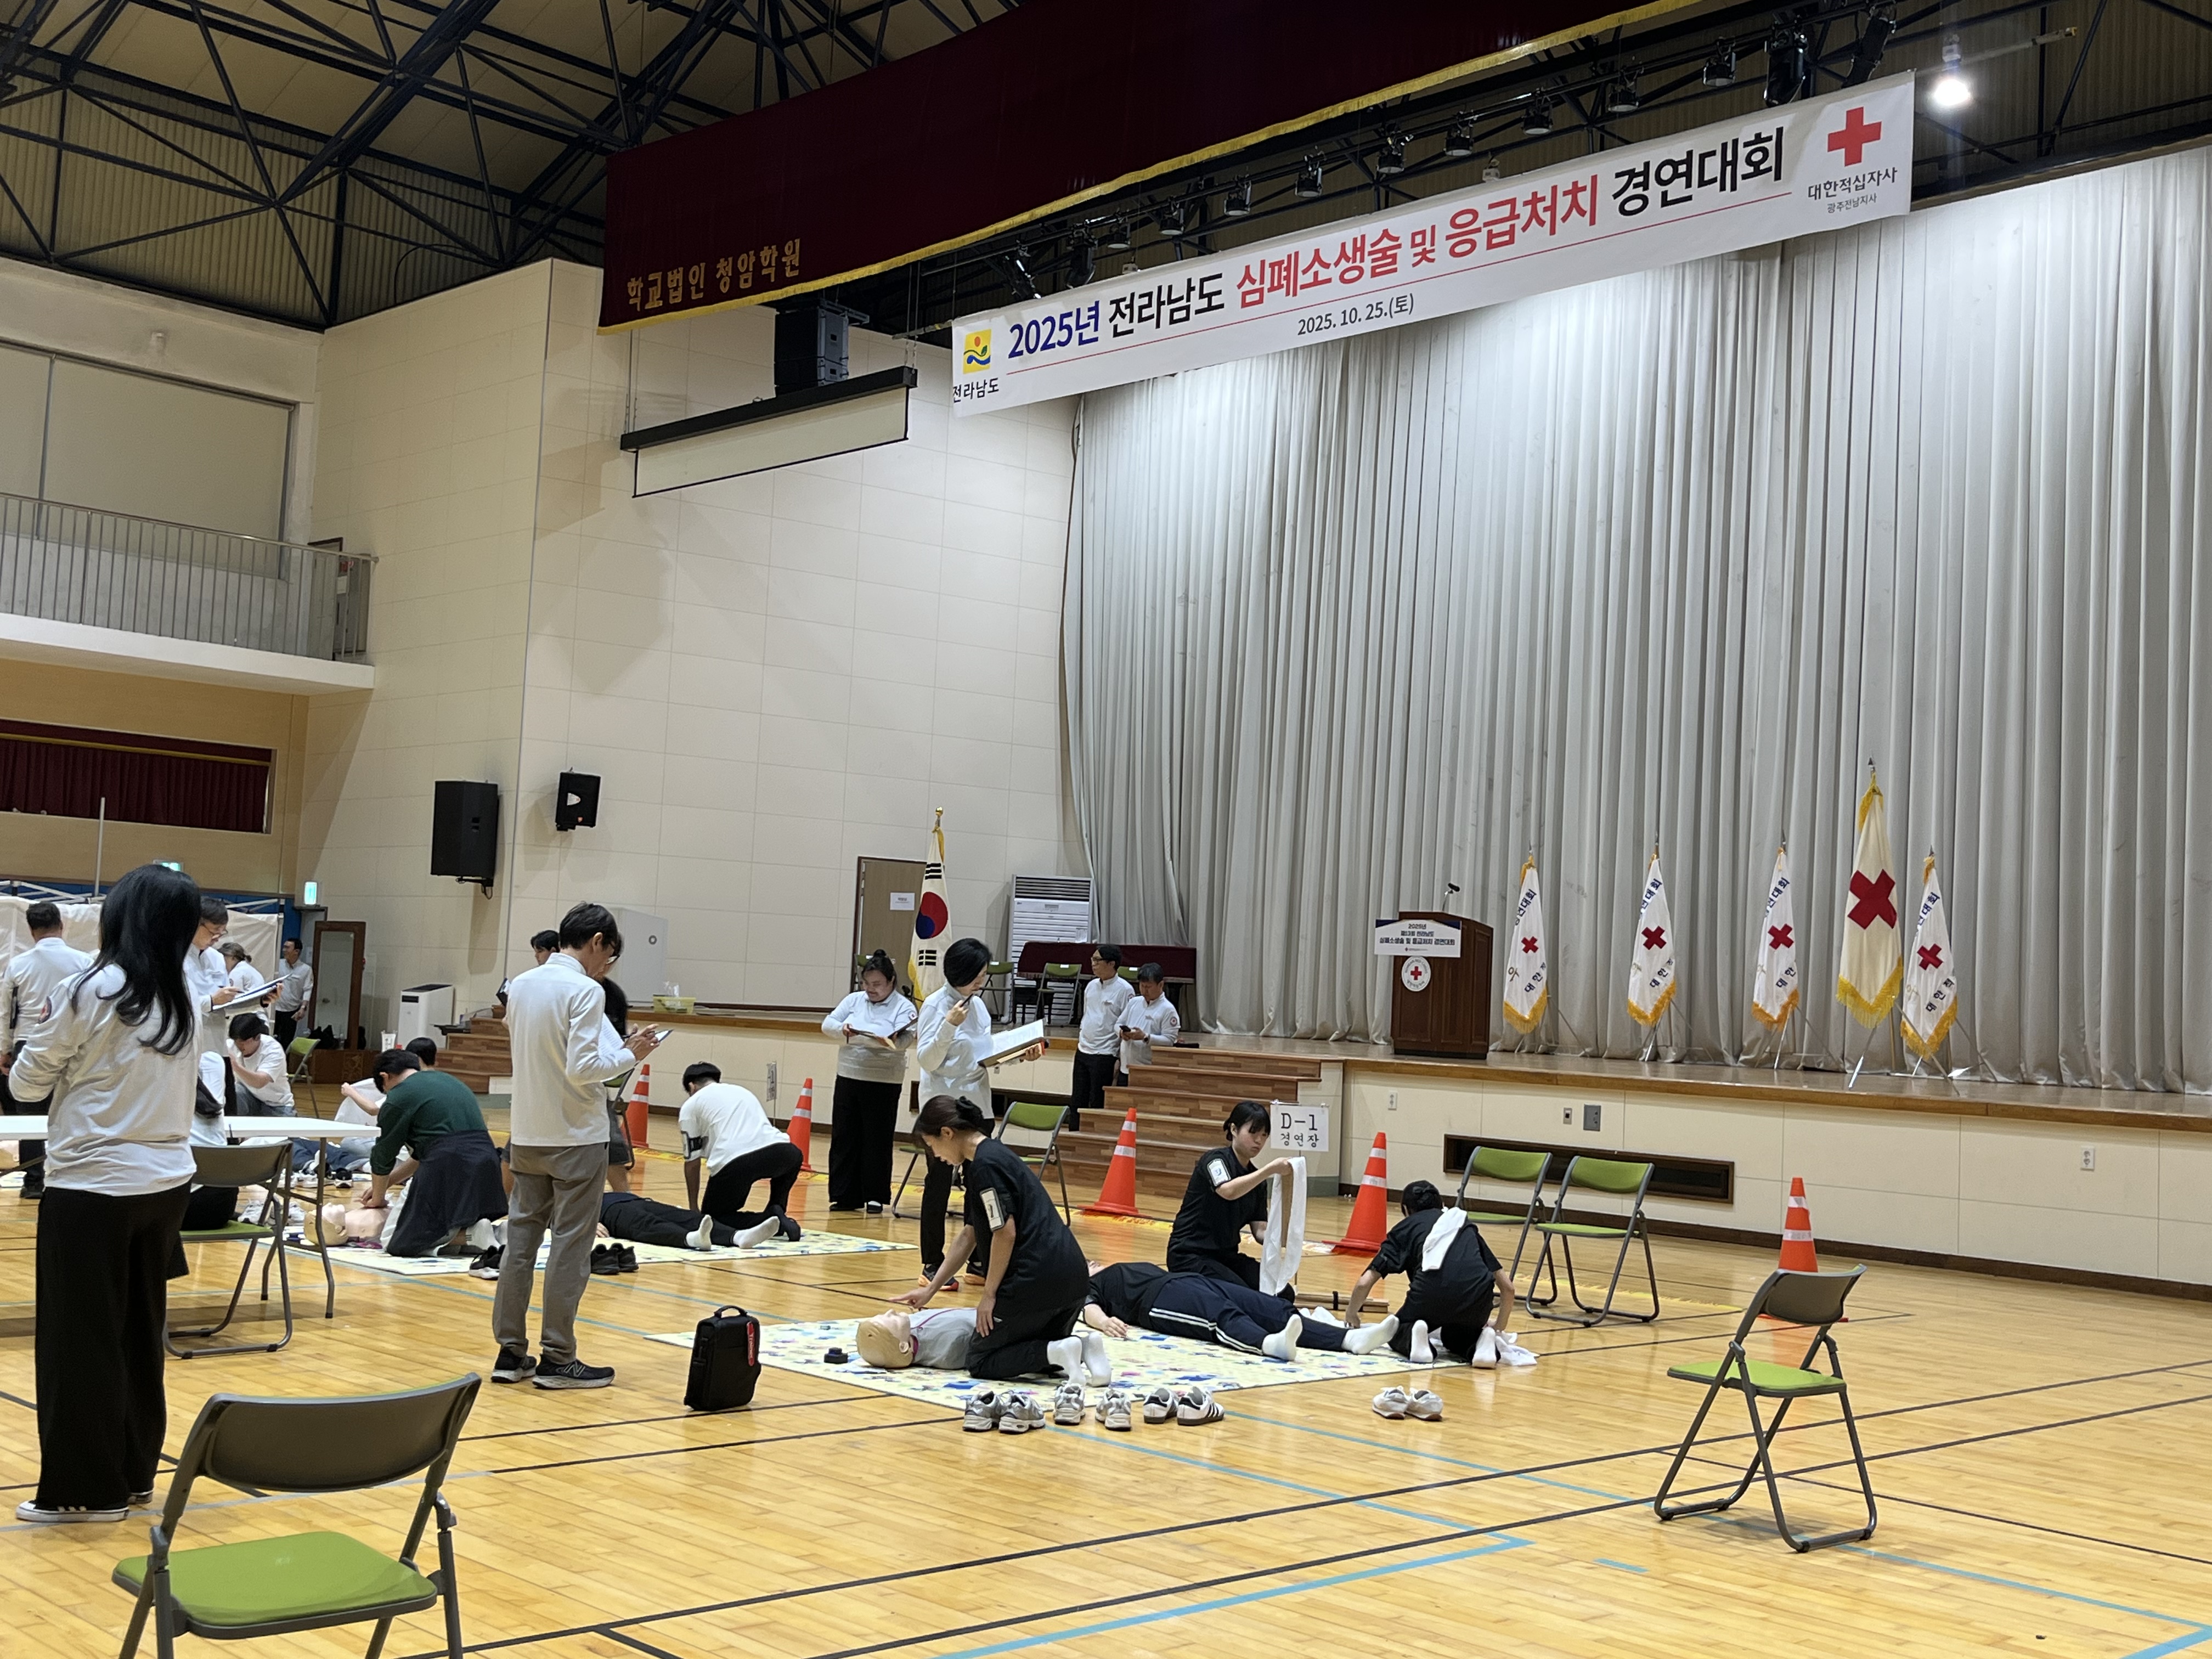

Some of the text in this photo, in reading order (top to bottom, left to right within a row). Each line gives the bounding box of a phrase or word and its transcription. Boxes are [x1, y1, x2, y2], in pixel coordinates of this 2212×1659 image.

[1808, 166, 1898, 201] 대한적십자사
[1827, 194, 1877, 215] 광주전남지사
[1008, 126, 1784, 359] 2025년 전라남도 심폐소생술 및 응급처치 경연대회
[627, 238, 801, 312] 학교법인 청암학원
[1297, 313, 1336, 336] 2025.
[1340, 307, 1362, 327] 10.
[952, 377, 1000, 403] 전라남도
[1280, 1113, 1318, 1131] D-1
[1280, 1132, 1320, 1148] 경연장
